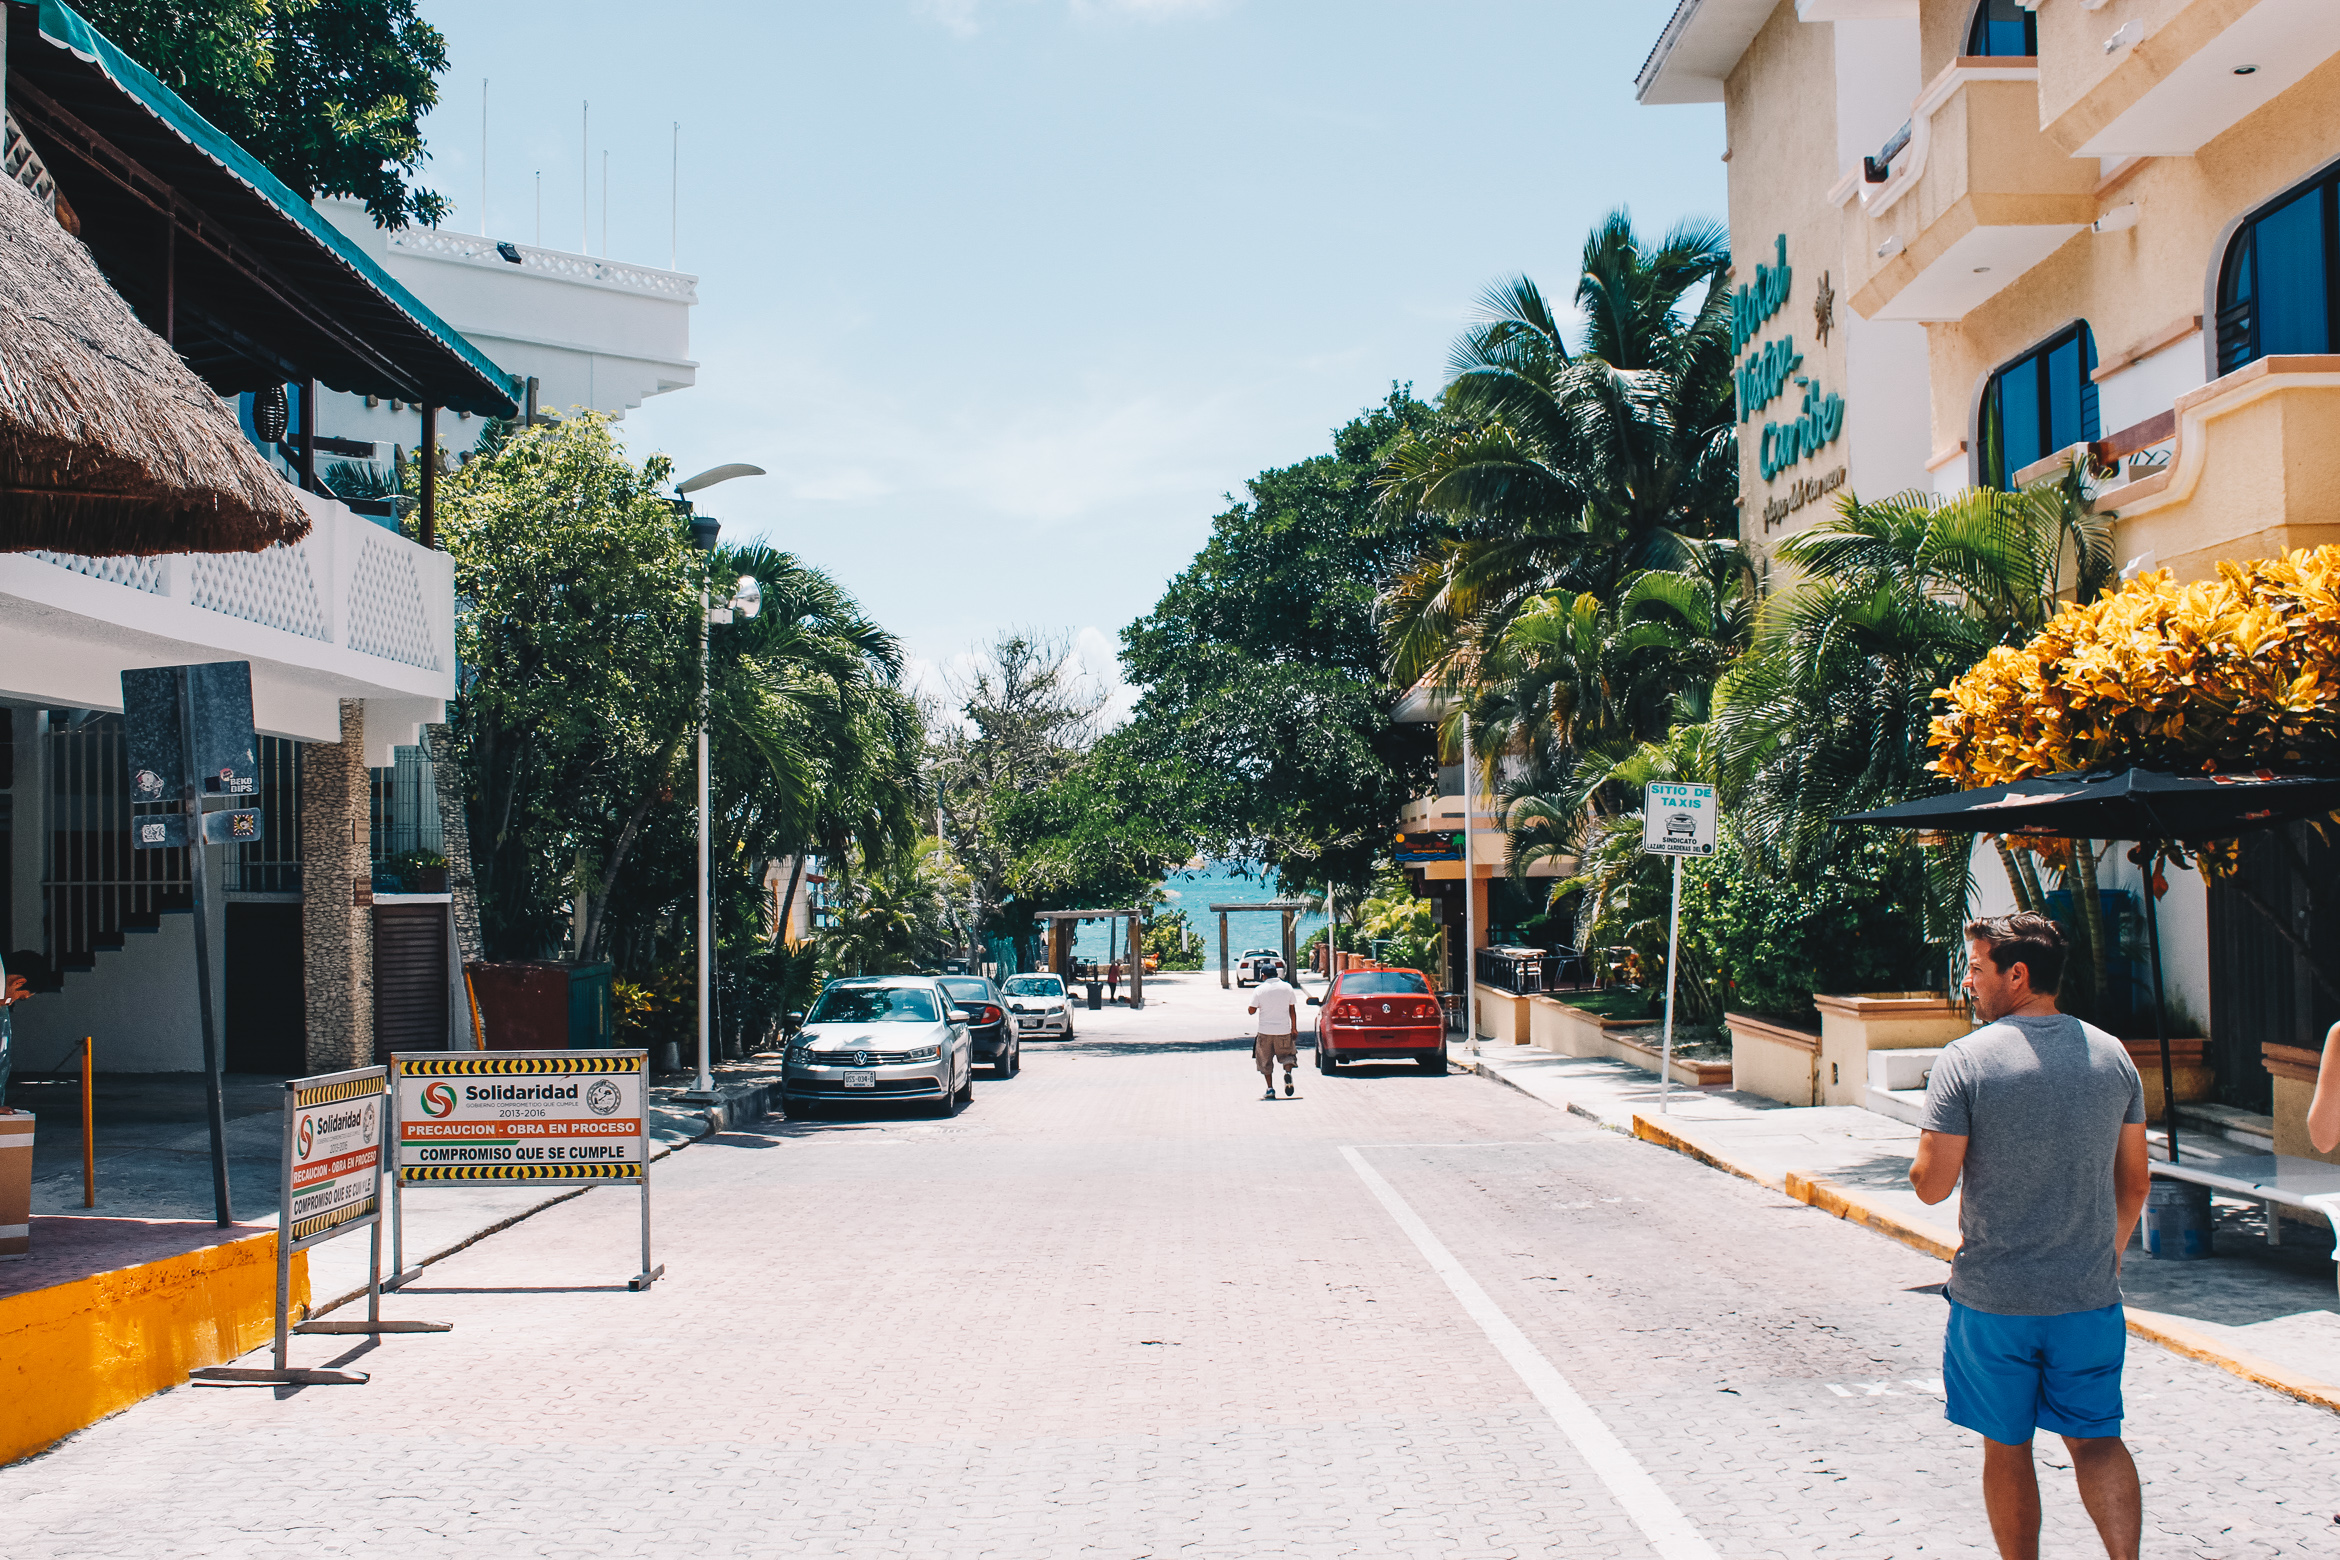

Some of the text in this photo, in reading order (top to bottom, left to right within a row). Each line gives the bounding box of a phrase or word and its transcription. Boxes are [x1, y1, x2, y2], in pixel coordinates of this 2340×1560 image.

[1730, 234, 1792, 357] Hotel
[1735, 334, 1804, 424] Vista
[1760, 377, 1845, 481] Caribe
[230, 785, 253, 793] DIPS
[1651, 785, 1712, 798] SITIO DE
[1661, 797, 1702, 809] TAXIS
[465, 1083, 579, 1101] Solidaridad
[316, 1108, 362, 1135] Solidaridad
[499, 1109, 546, 1118] 2013-2016
[407, 1124, 496, 1136] PRECAUCION
[506, 1123, 545, 1135] OBRA
[548, 1123, 568, 1134] EN
[571, 1122, 636, 1134] PROCESO
[419, 1145, 625, 1161] COMPROMISO QUE SE CUMPLE
[293, 1164, 328, 1184] RECAUCION
[332, 1159, 346, 1174] OBRA
[347, 1156, 355, 1170] EN
[355, 1150, 377, 1167] PROCESO
[294, 1192, 332, 1215] COMPROMISO
[333, 1187, 345, 1204] QUE
[346, 1184, 353, 1200] SE
